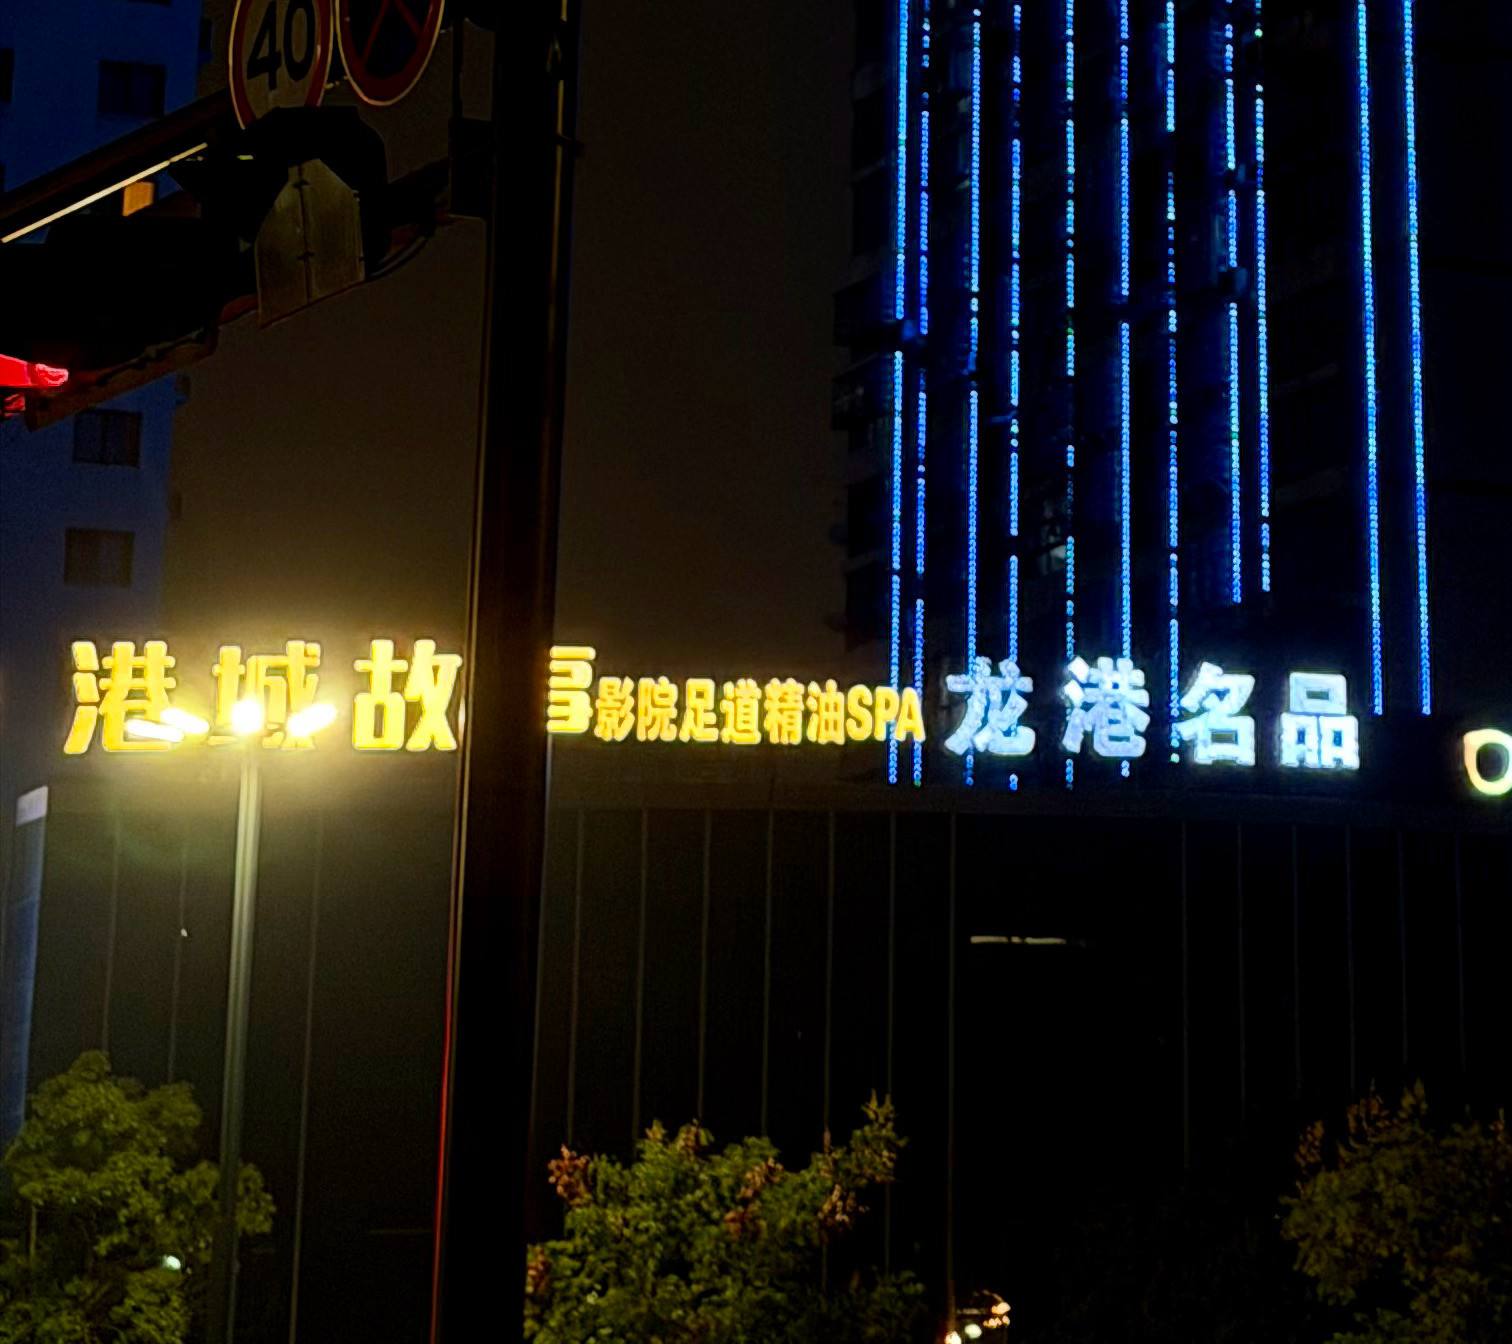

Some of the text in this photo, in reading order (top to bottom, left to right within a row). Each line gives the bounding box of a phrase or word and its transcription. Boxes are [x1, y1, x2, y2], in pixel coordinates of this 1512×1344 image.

[594, 675, 927, 746] 影院足道精油SPA
[943, 654, 1361, 771] 龙港名品
